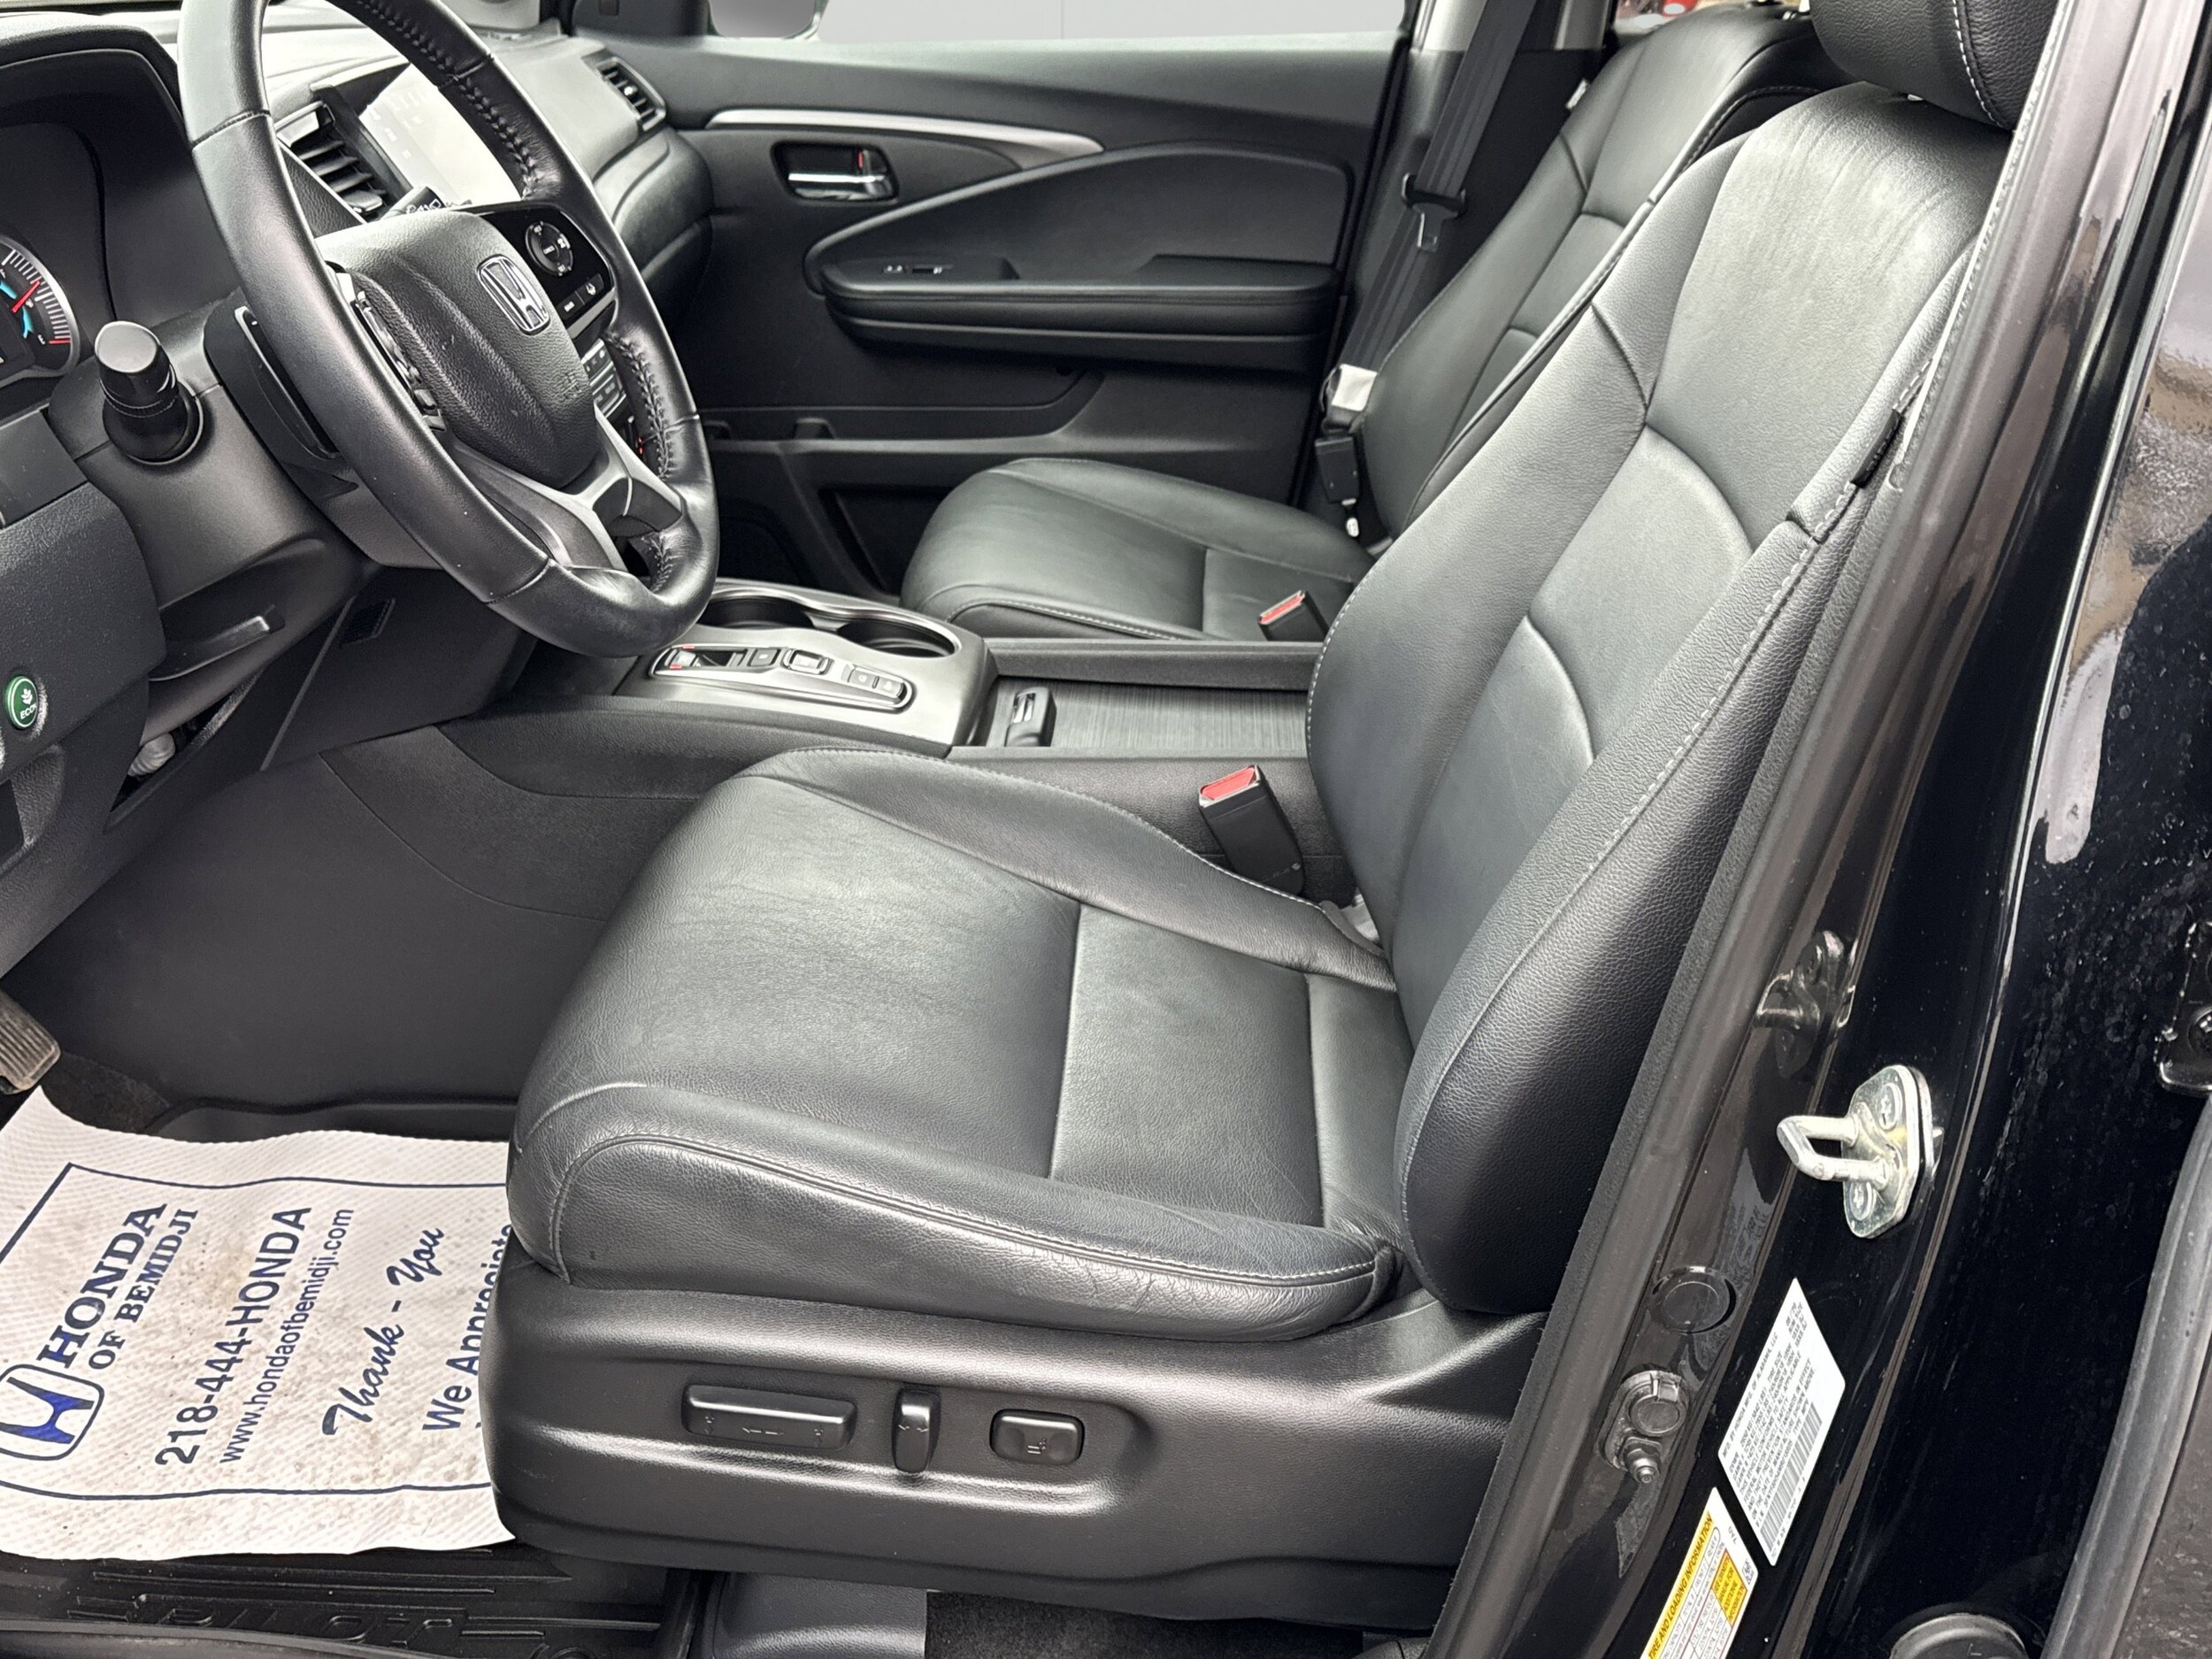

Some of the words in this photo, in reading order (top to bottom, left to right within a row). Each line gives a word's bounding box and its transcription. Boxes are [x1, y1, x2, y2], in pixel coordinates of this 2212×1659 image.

[36, 1203, 167, 1369] HONDA
[88, 1330, 126, 1370] OF
[114, 1209, 198, 1323] BEMIDJI
[154, 1207, 312, 1465] 218-444-HONDA
[219, 1209, 354, 1463] www.hondaofbemidji.com
[322, 1324, 405, 1435] Thank
[386, 1227, 445, 1286] You
[421, 1385, 472, 1430] We
[1658, 1618, 1671, 1640] AND
[1670, 1580, 1688, 1620] LOADING
[1685, 1514, 1713, 1580] INFORMATION
